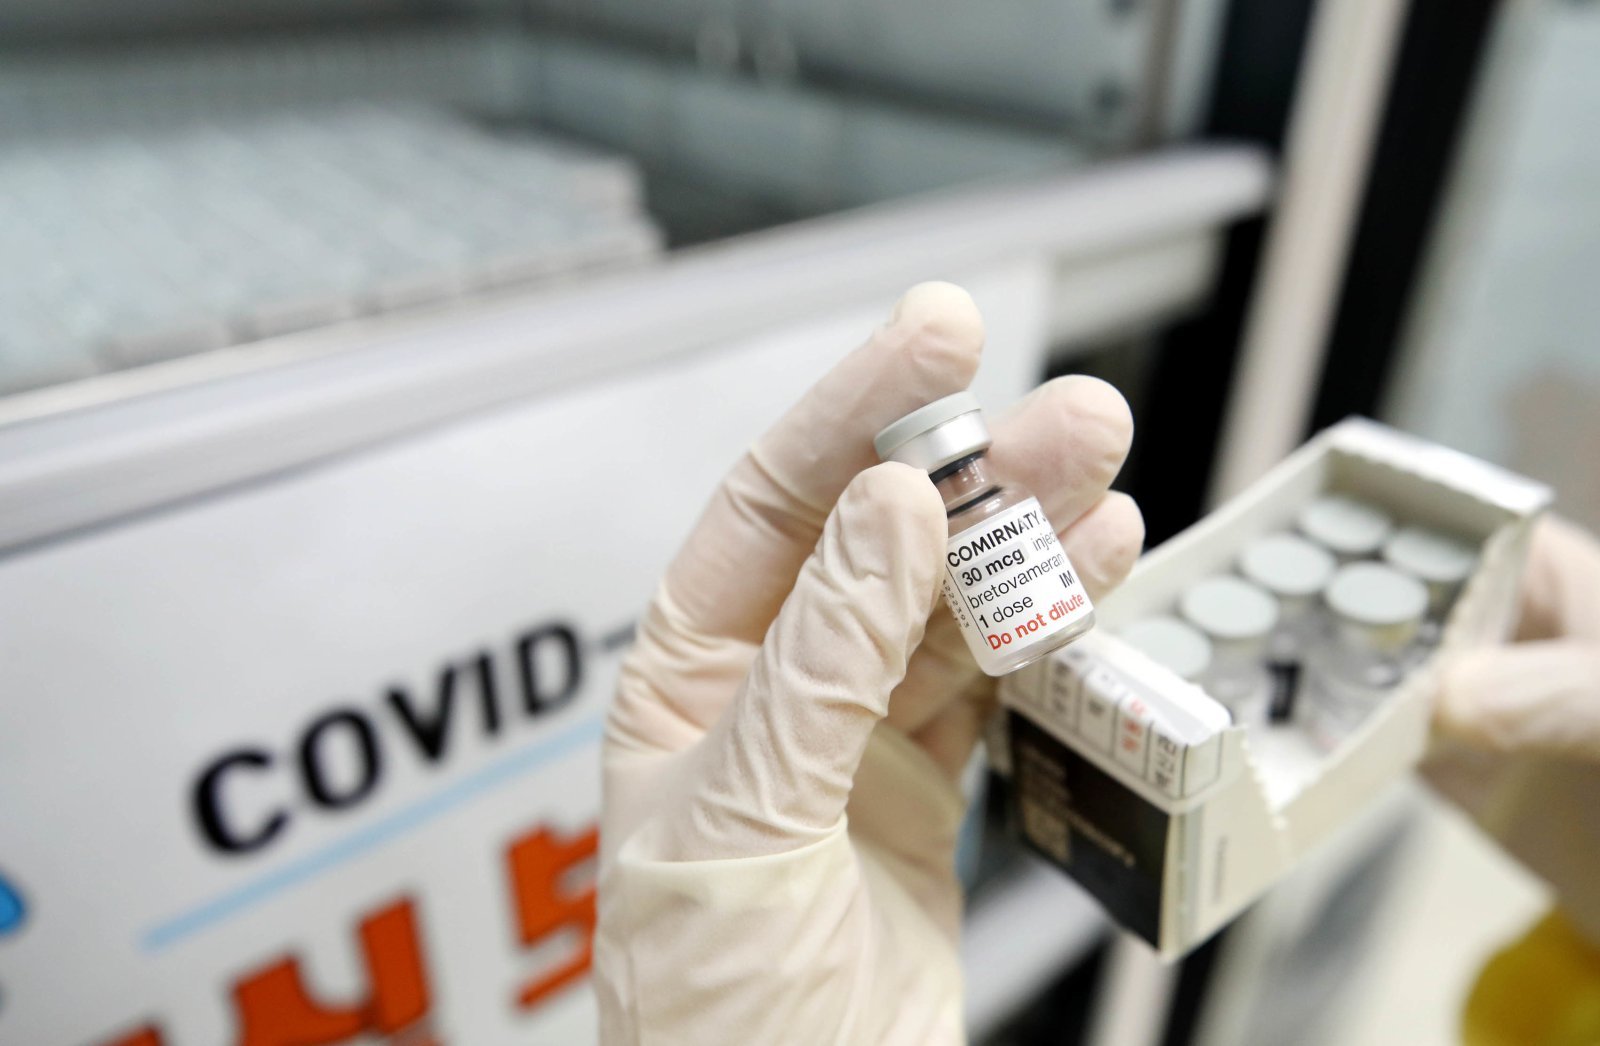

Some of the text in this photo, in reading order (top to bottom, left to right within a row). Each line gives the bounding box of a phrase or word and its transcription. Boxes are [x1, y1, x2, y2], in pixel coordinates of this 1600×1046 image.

[947, 510, 1039, 567] COMIRNATY
[961, 567, 982, 588] 30
[985, 548, 1025, 576] mcg
[967, 552, 1065, 609] bretovameran
[978, 569, 1075, 629] 1 dose IM
[987, 592, 1086, 651] Do not dilute
